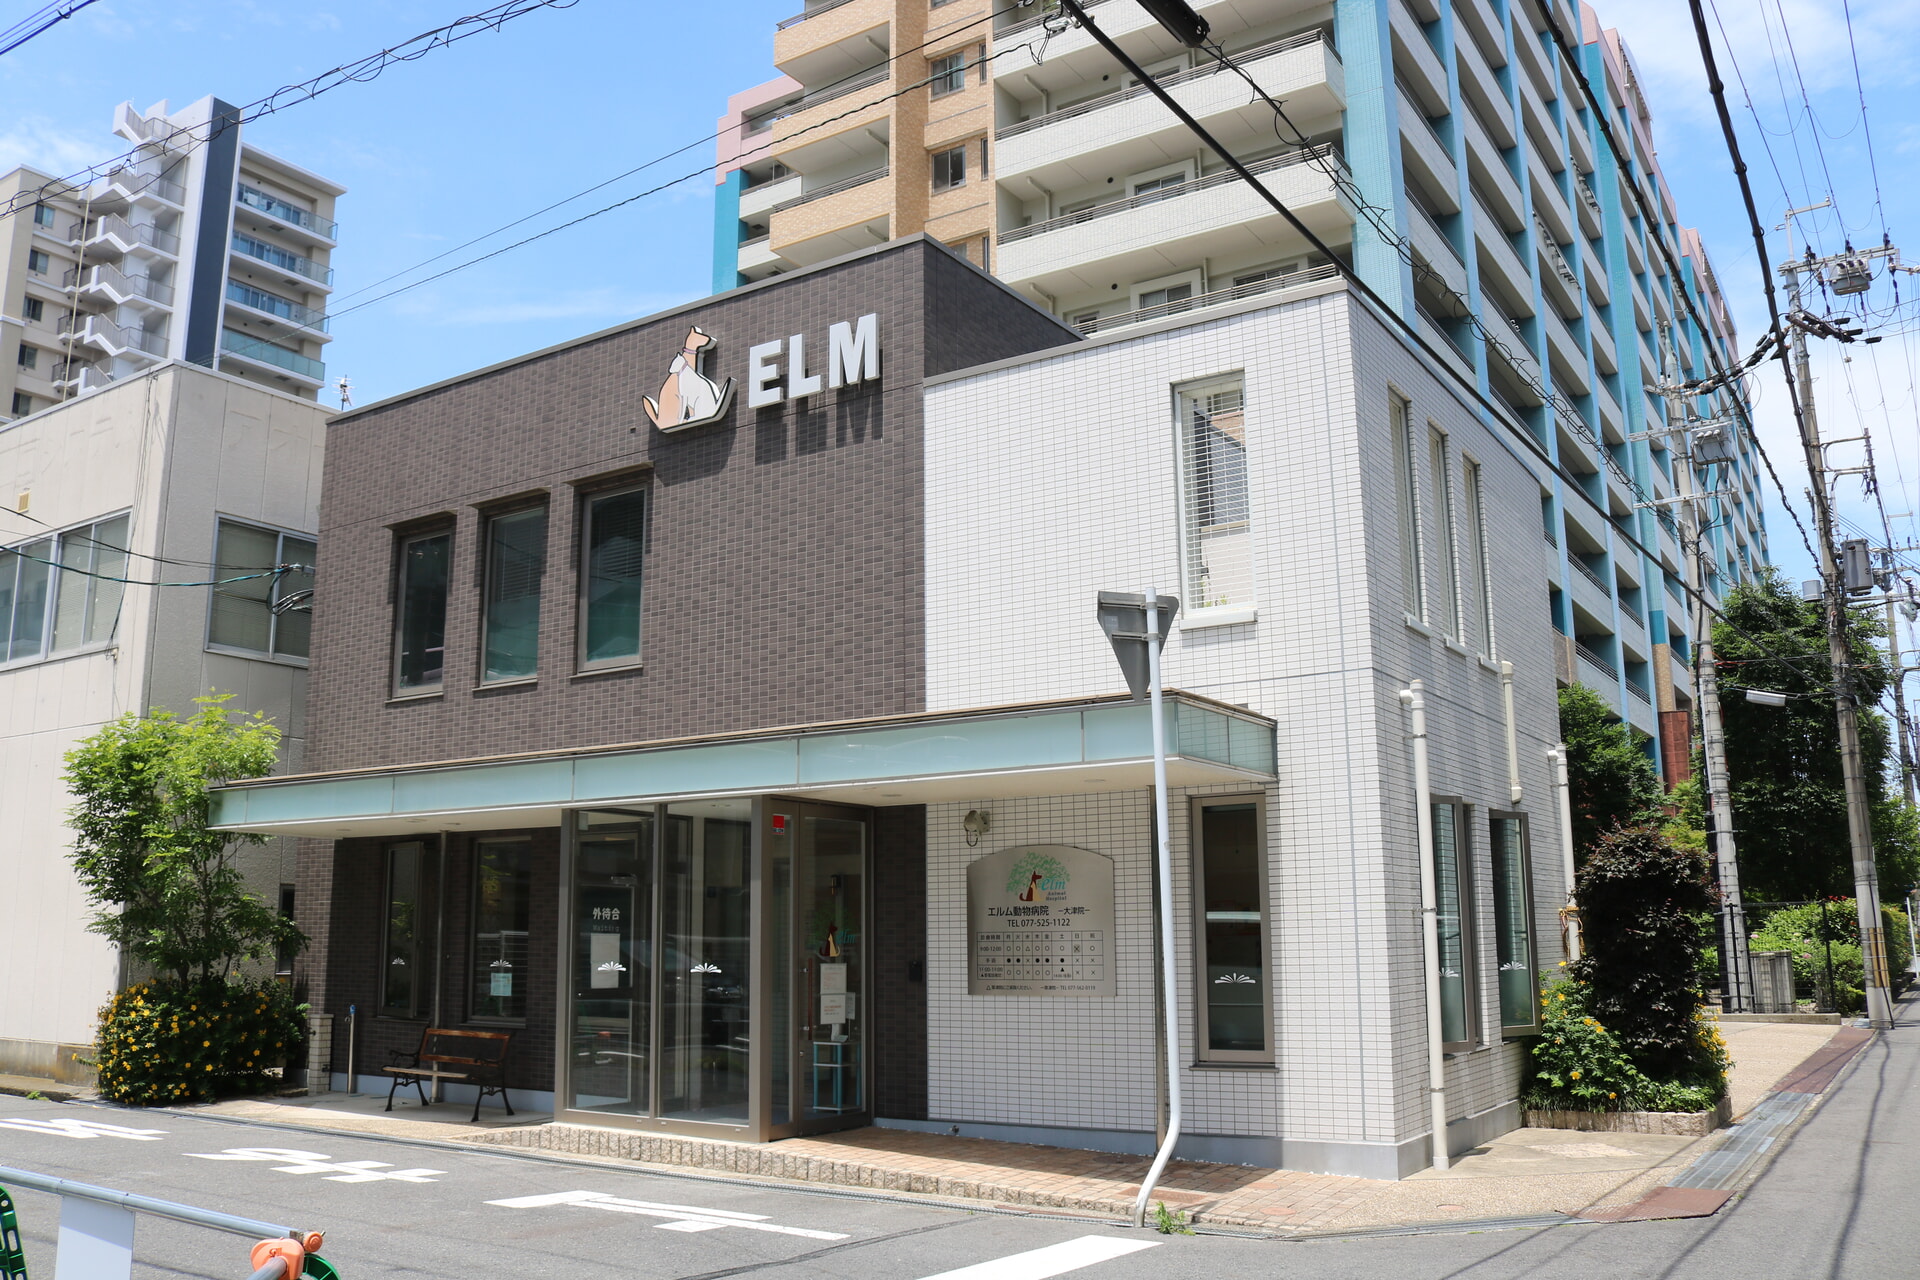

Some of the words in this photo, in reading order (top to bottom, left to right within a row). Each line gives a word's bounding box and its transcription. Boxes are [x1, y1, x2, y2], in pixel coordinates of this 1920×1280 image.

[749, 313, 880, 409] ELM
[1041, 877, 1066, 890] elm
[592, 906, 621, 920] 外待合
[988, 905, 1049, 916] エルム動物病院
[1007, 919, 1020, 928] TEL
[1021, 919, 1070, 927] 077-525-1122
